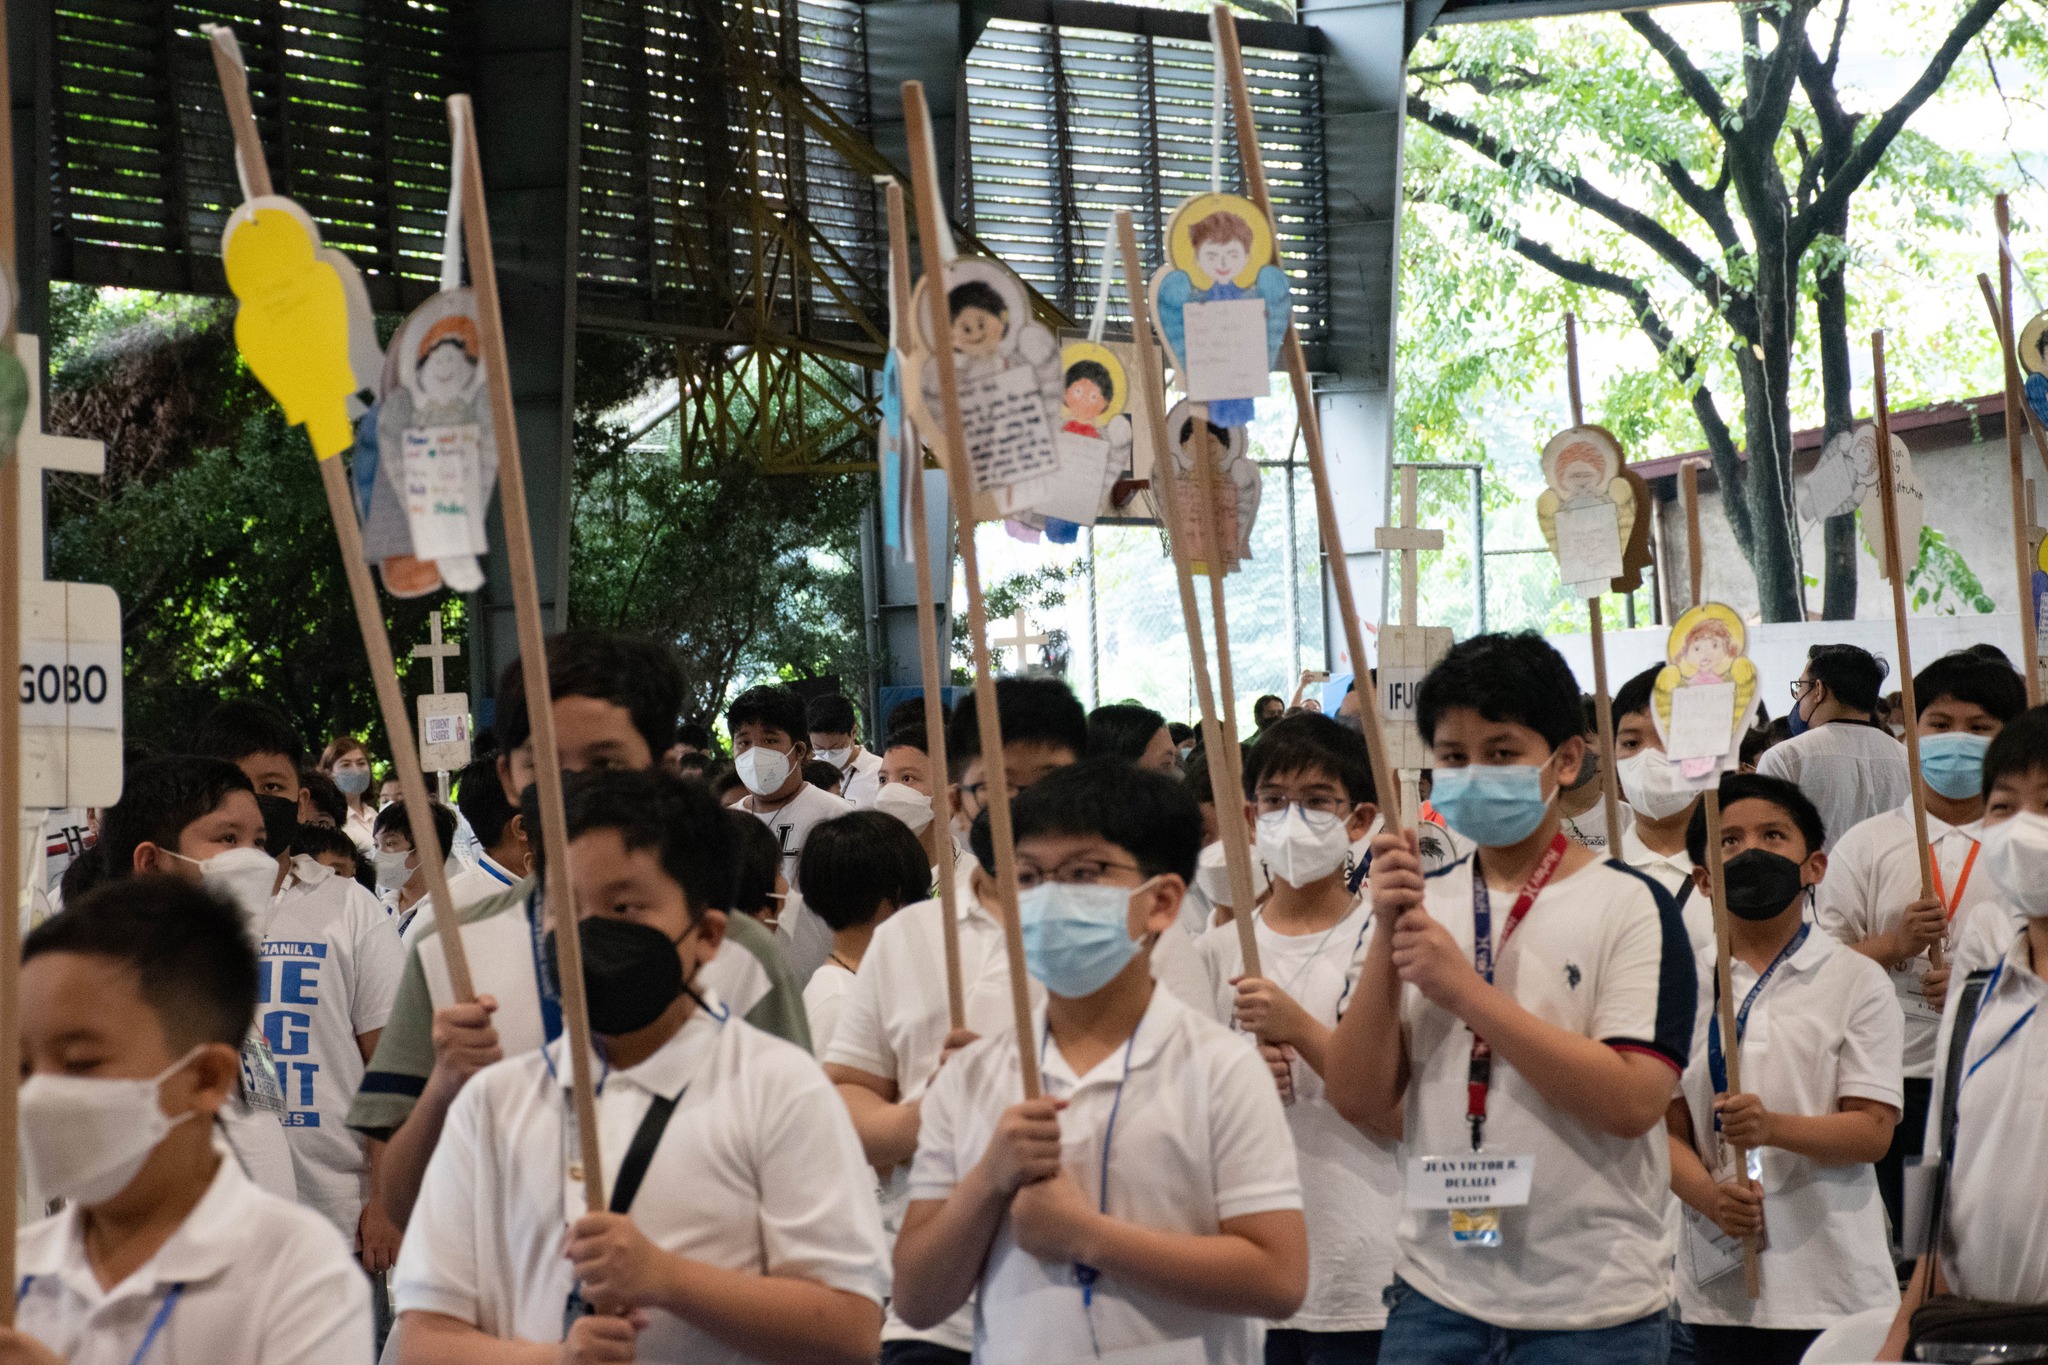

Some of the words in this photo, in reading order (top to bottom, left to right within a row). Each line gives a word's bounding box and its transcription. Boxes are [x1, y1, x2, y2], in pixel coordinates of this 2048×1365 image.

[19, 664, 107, 704] GOBO
[258, 943, 314, 956] MANILA
[1460, 1160, 1504, 1172] VICTOR
